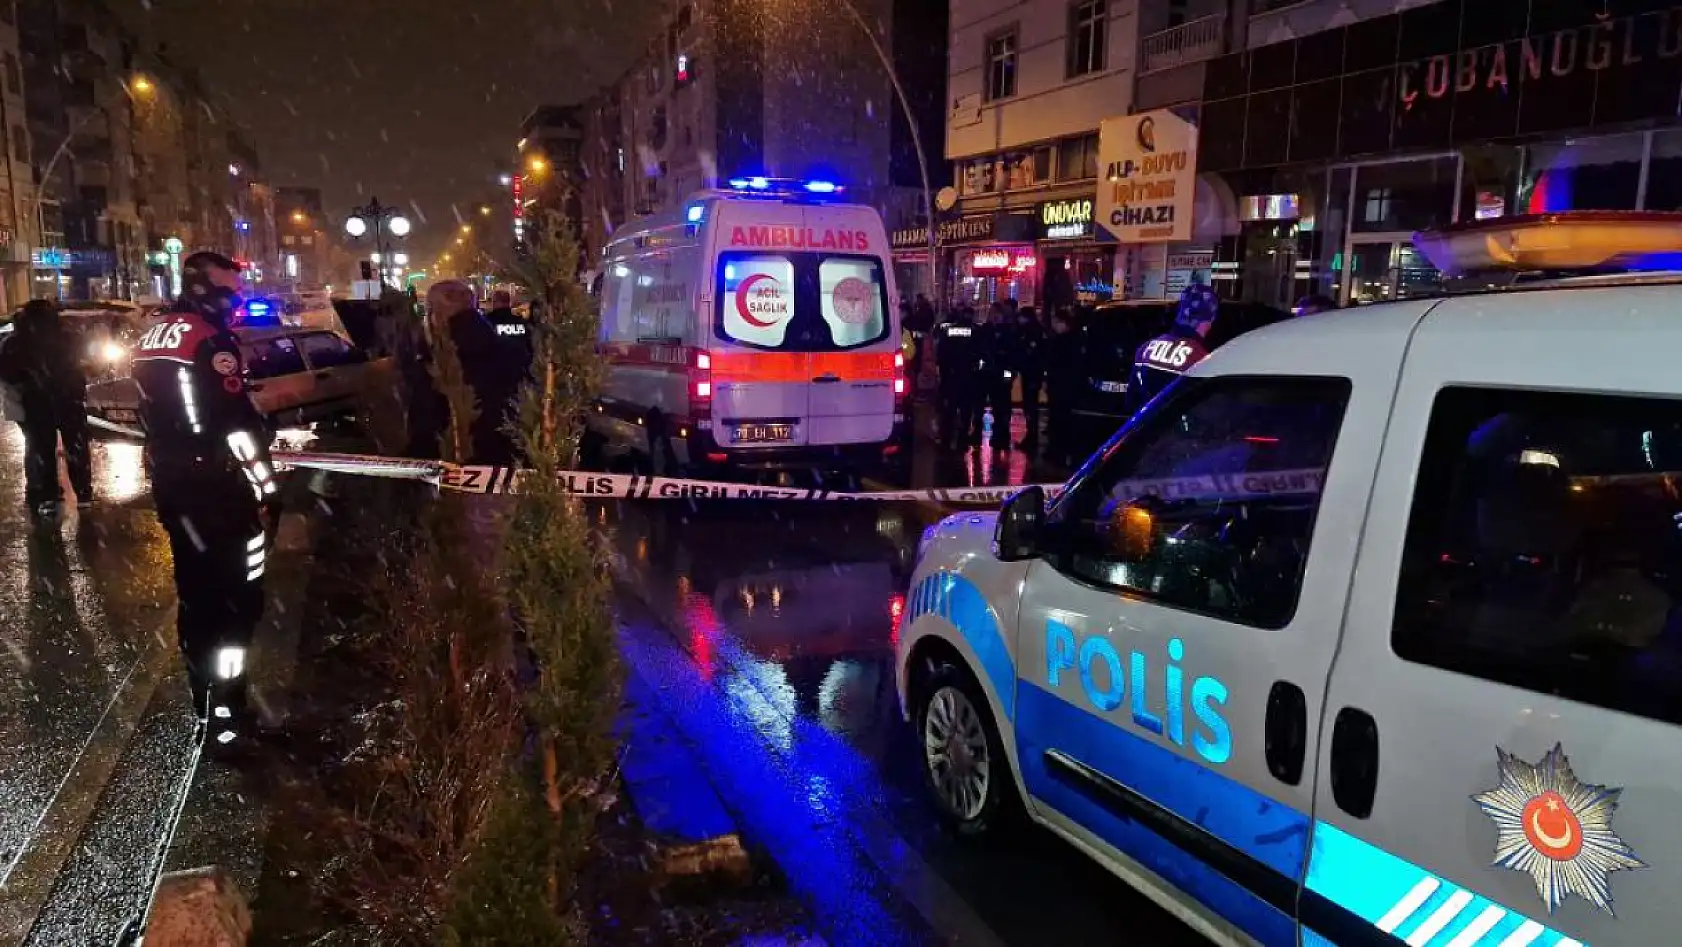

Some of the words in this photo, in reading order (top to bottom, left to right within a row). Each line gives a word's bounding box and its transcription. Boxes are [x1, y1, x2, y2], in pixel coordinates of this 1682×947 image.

[1110, 205, 1175, 226] CİHAZI
[731, 225, 869, 251] AMBULANS
[1045, 616, 1233, 764] POLİS
